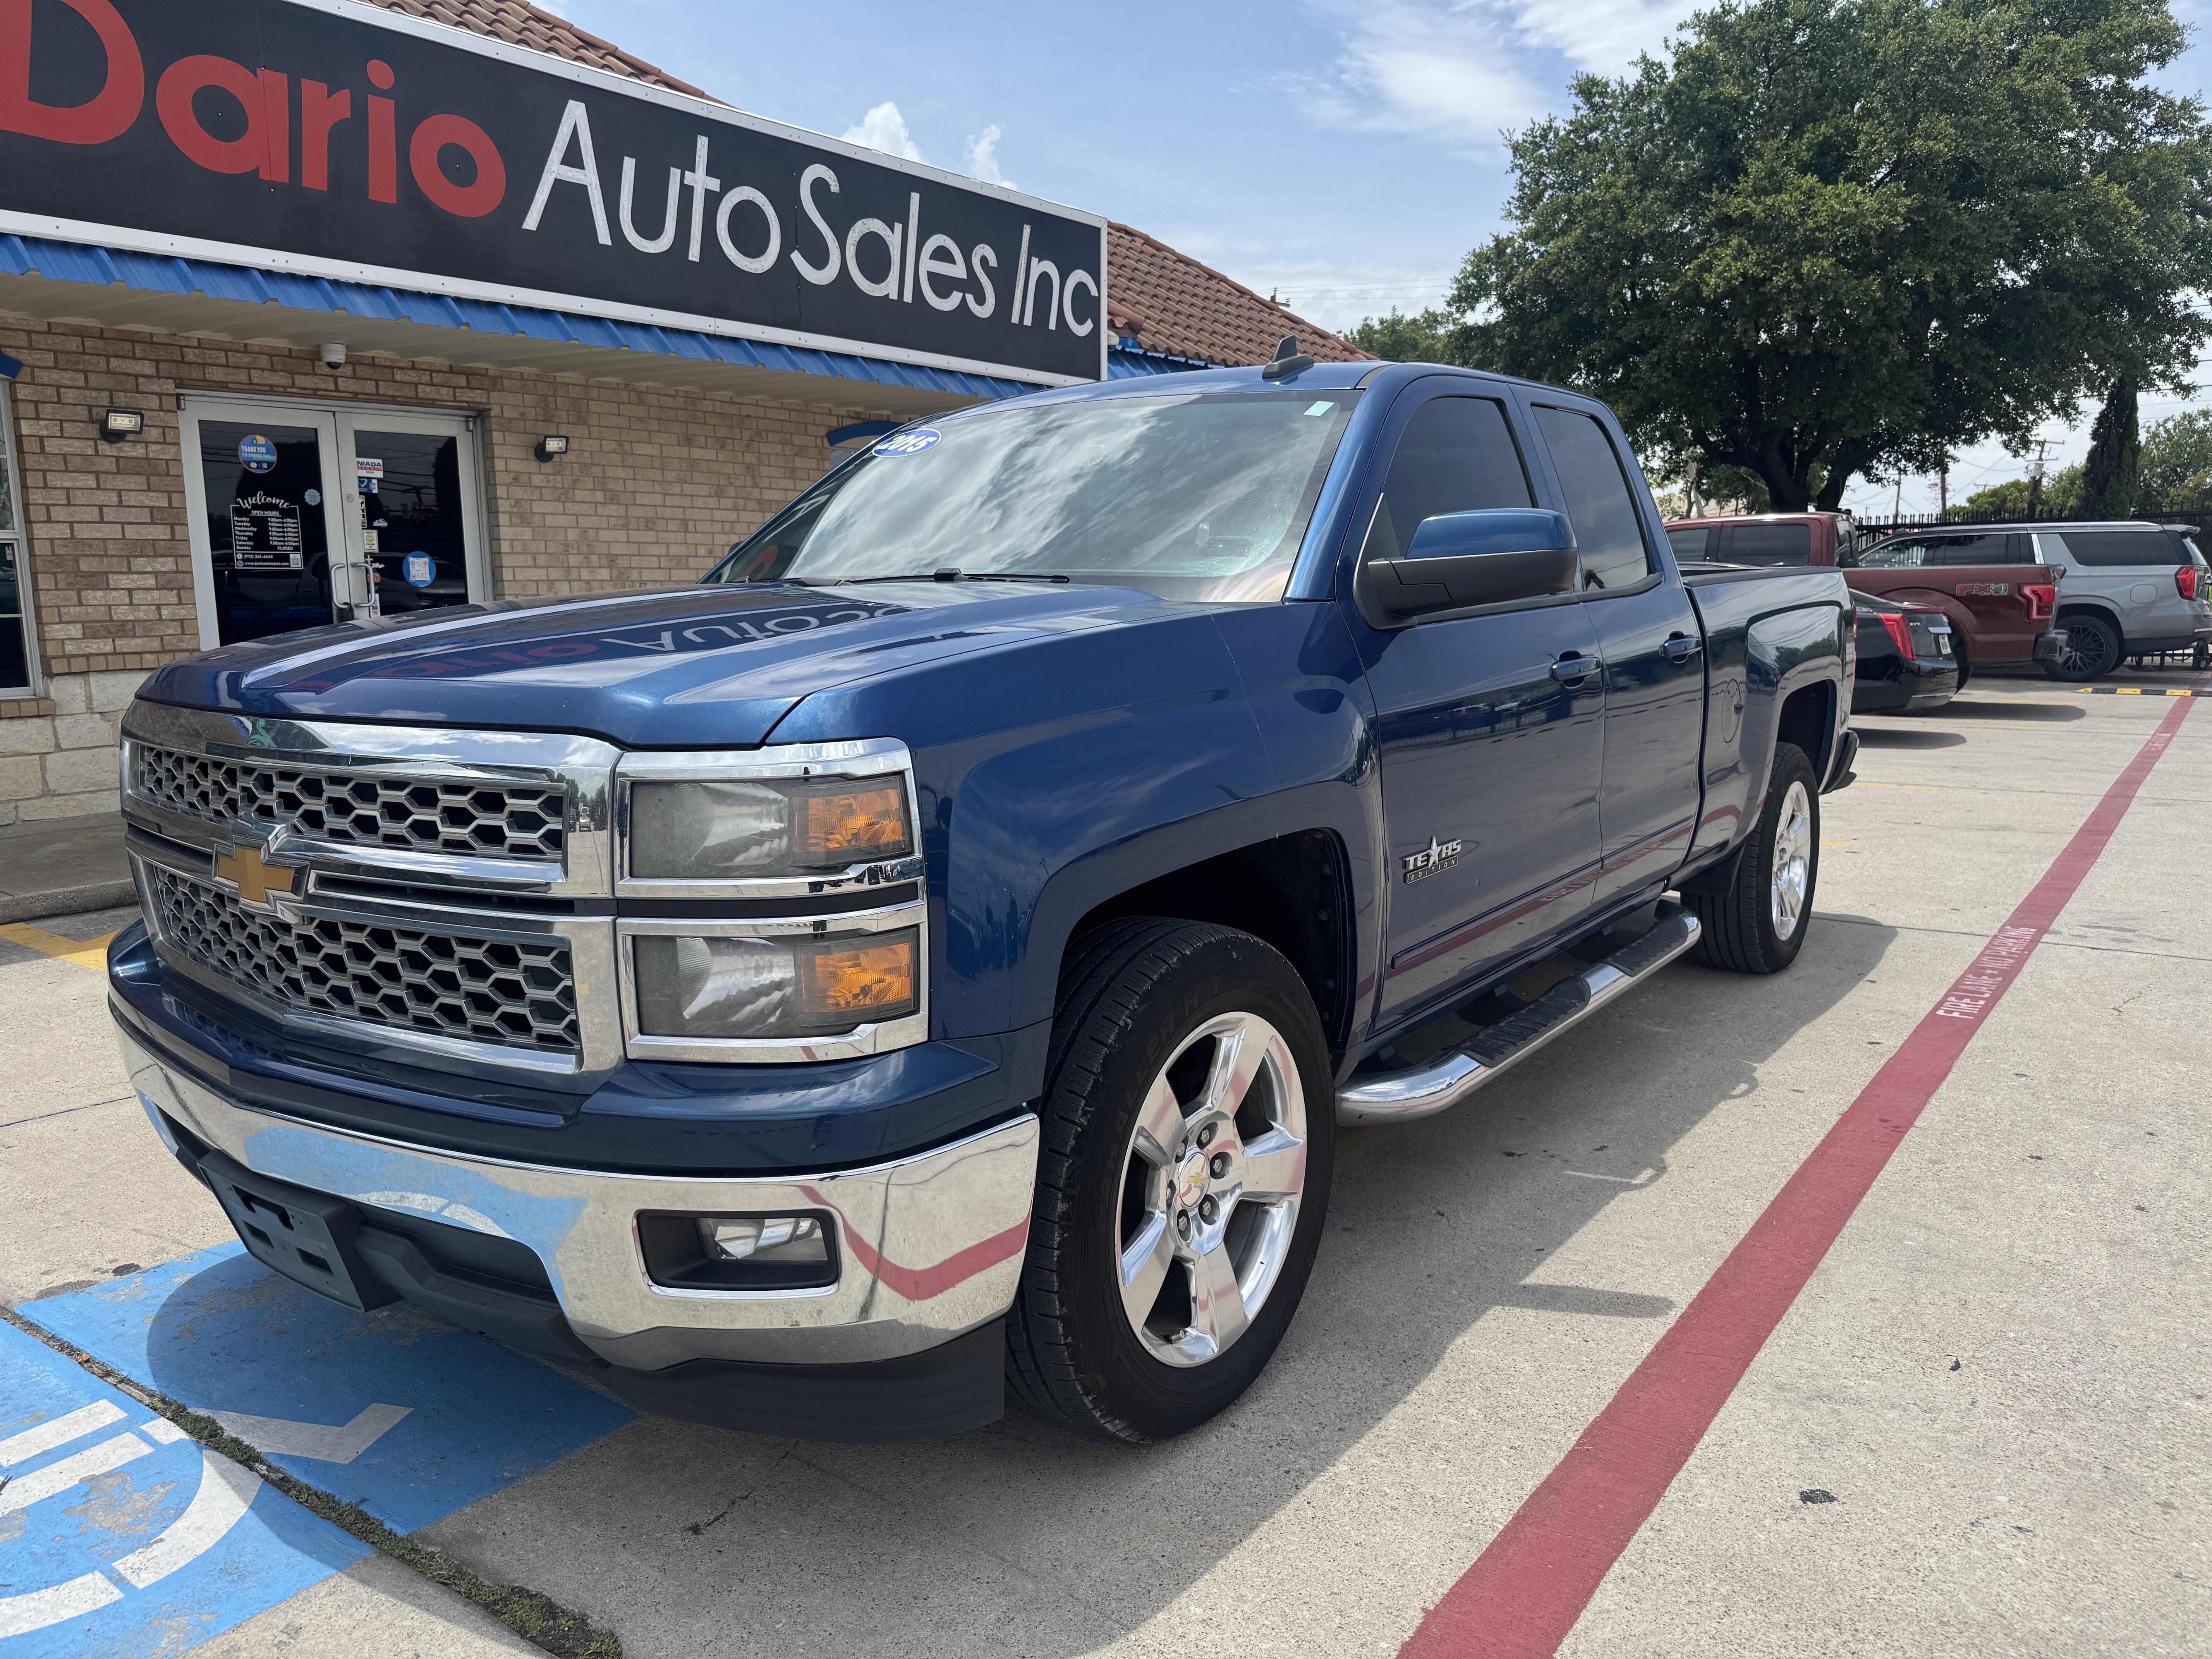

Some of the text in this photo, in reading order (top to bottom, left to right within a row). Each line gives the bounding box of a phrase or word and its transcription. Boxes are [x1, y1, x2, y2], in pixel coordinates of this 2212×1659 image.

[0, 0, 505, 216] Dario
[1011, 224, 1099, 337] Inc
[876, 435, 938, 453] 2015
[237, 491, 290, 509] Welcome
[1956, 584, 2008, 596] FX4
[1411, 859, 1455, 880] EDITION
[1936, 926, 2037, 1019] FIRE LANE NO PARKING
